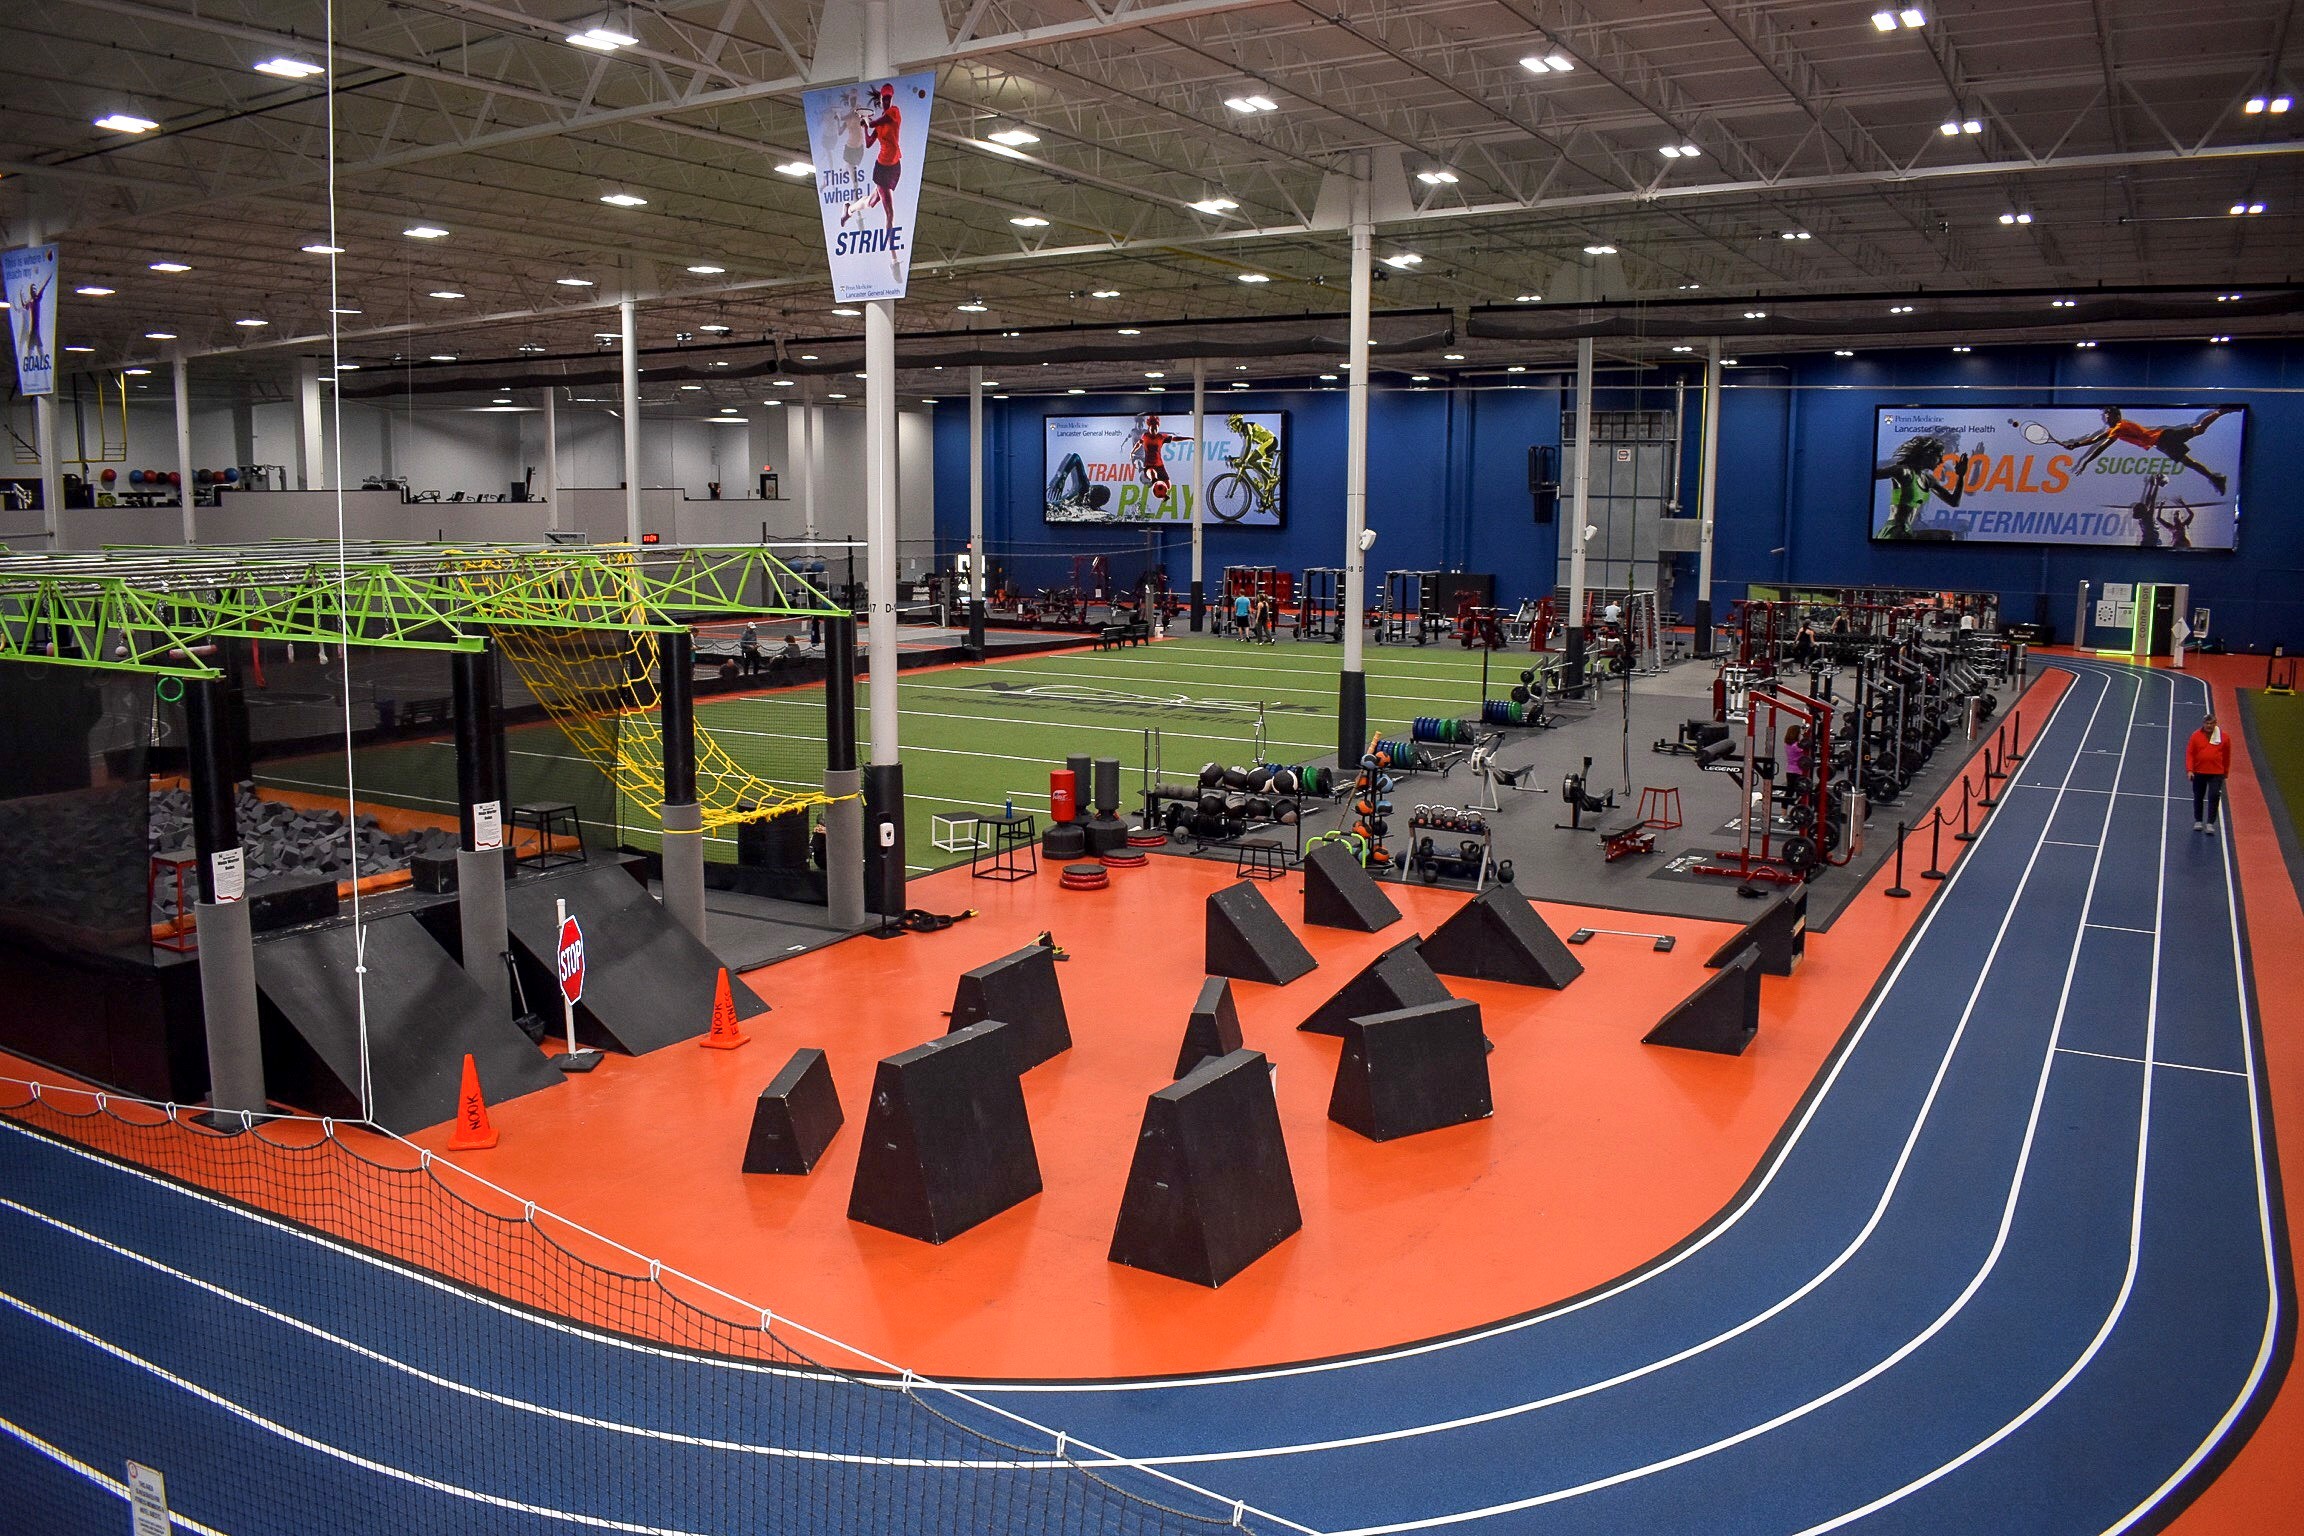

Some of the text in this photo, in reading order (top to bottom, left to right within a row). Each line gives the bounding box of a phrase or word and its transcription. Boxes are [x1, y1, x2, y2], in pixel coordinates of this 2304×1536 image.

[823, 167, 865, 187] This is
[824, 183, 871, 204] where I
[835, 226, 905, 256] STRIVE.
[867, 289, 885, 297] General
[23, 354, 52, 372] GOALS.
[1056, 430, 1082, 438] Lancaster
[1104, 429, 1123, 437] Health
[1894, 425, 1996, 434] Lancaster General Health
[1087, 463, 1137, 482] TRAIN
[1933, 453, 2073, 494] GOALS
[2095, 456, 2186, 476] SUCCEED
[1117, 484, 1194, 520] PLAY
[1933, 509, 2137, 537] DETERMINATION
[1704, 765, 1741, 773] LEGEND
[560, 939, 581, 982] STOP
[713, 1002, 724, 1036] NOOK
[466, 1092, 482, 1131] NOOK
